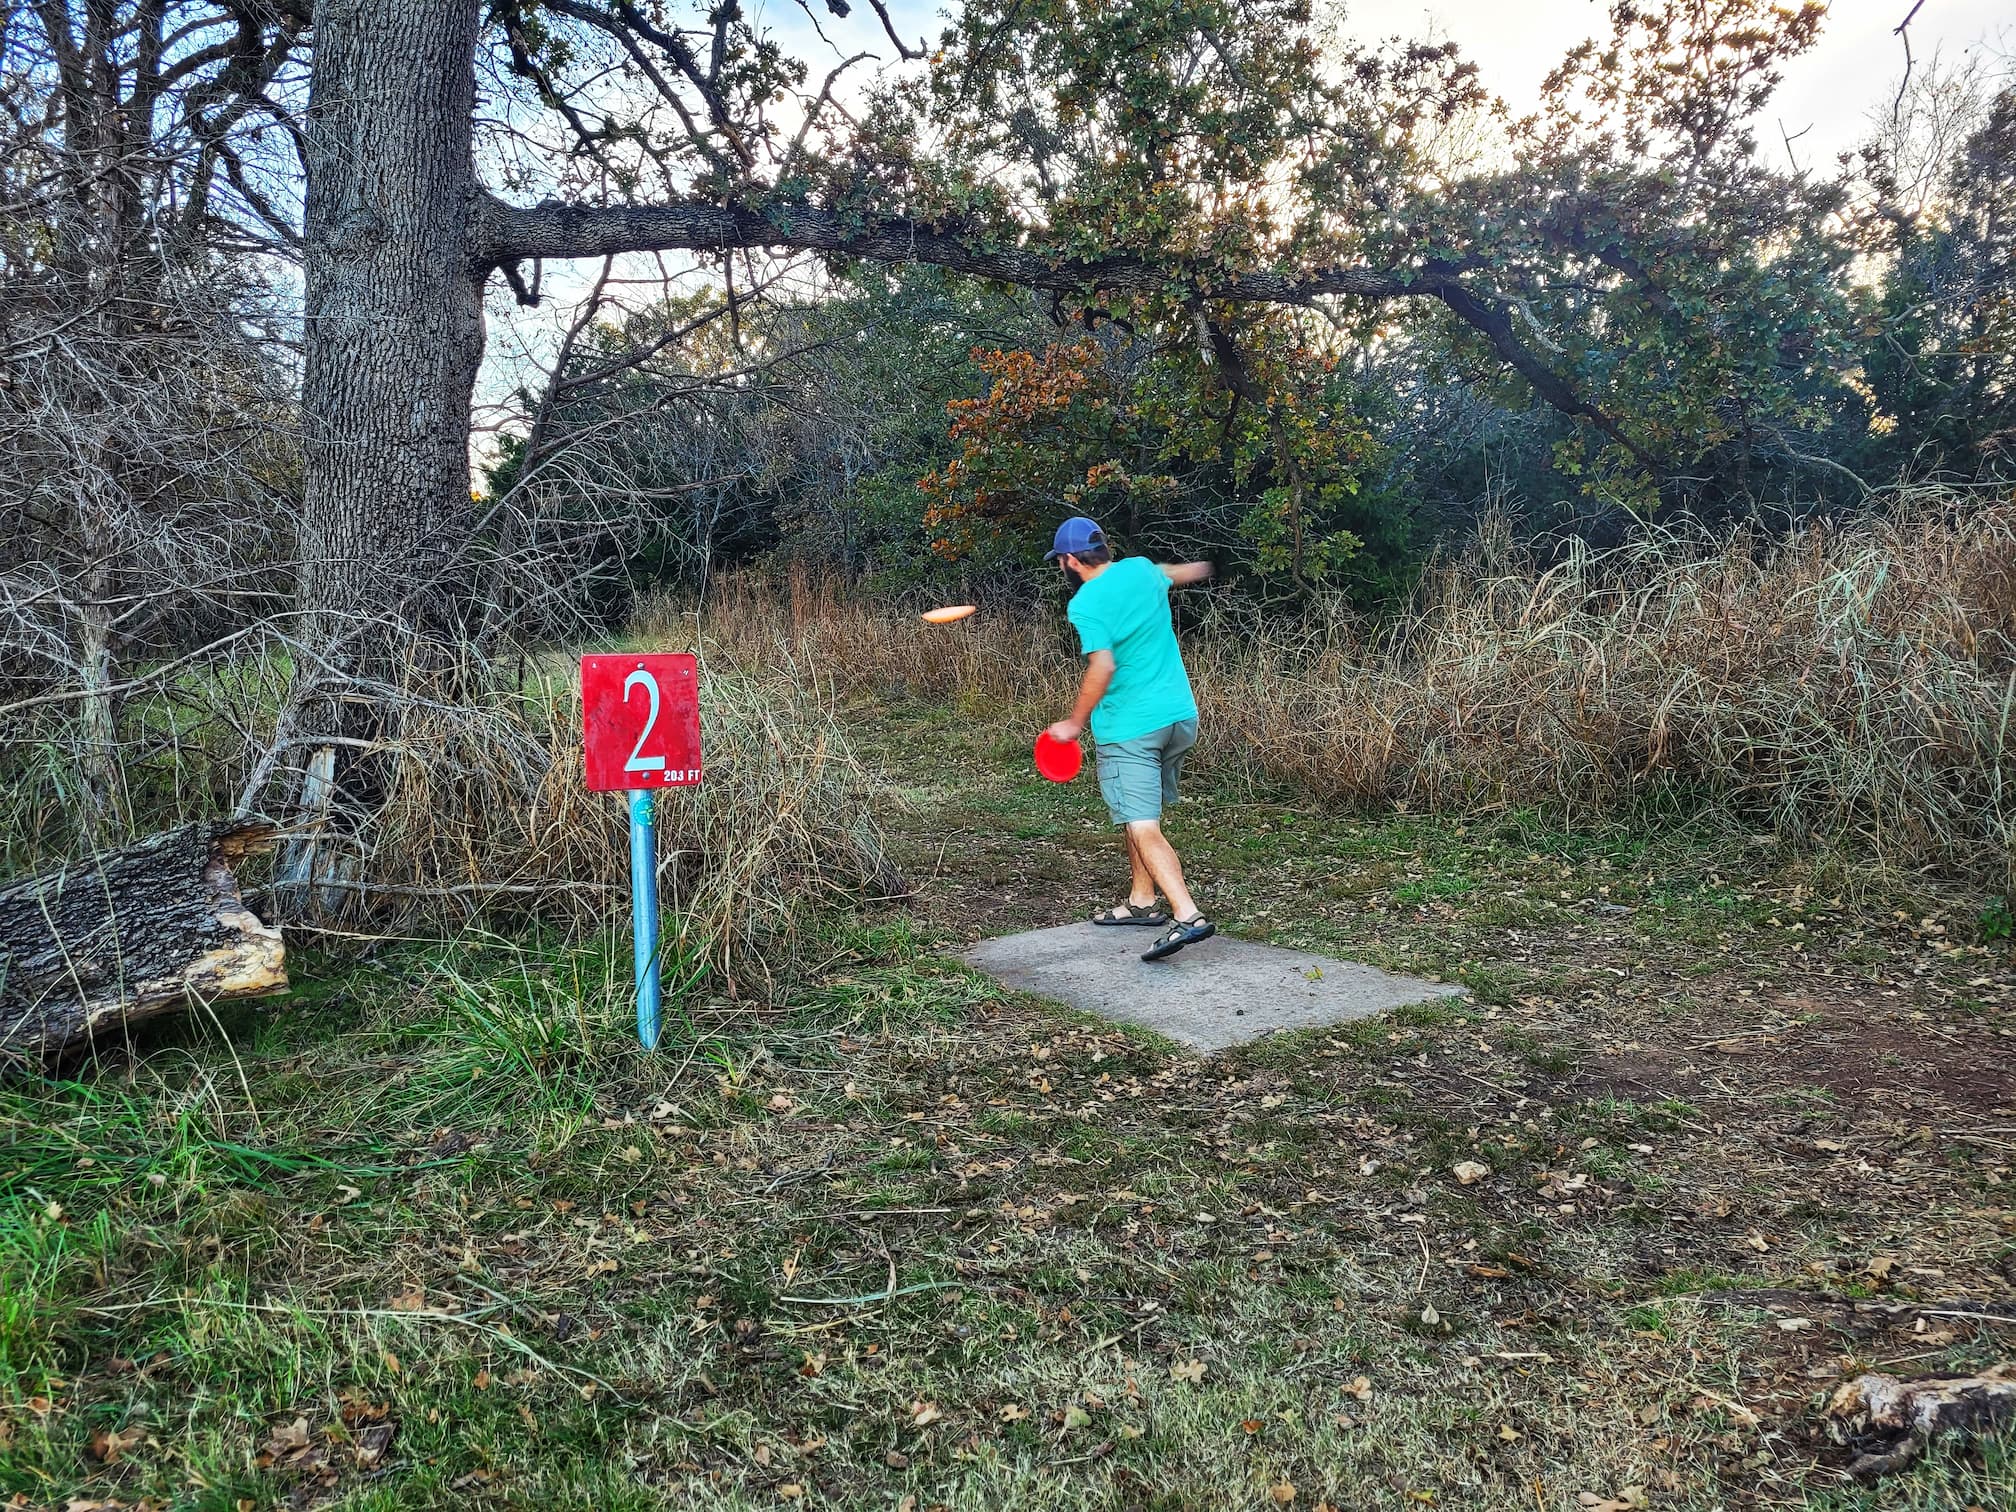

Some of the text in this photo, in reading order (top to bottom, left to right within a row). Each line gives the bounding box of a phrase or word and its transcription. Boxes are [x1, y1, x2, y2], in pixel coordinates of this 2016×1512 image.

[623, 669, 666, 772] 2
[664, 769, 700, 782] 203 FT
